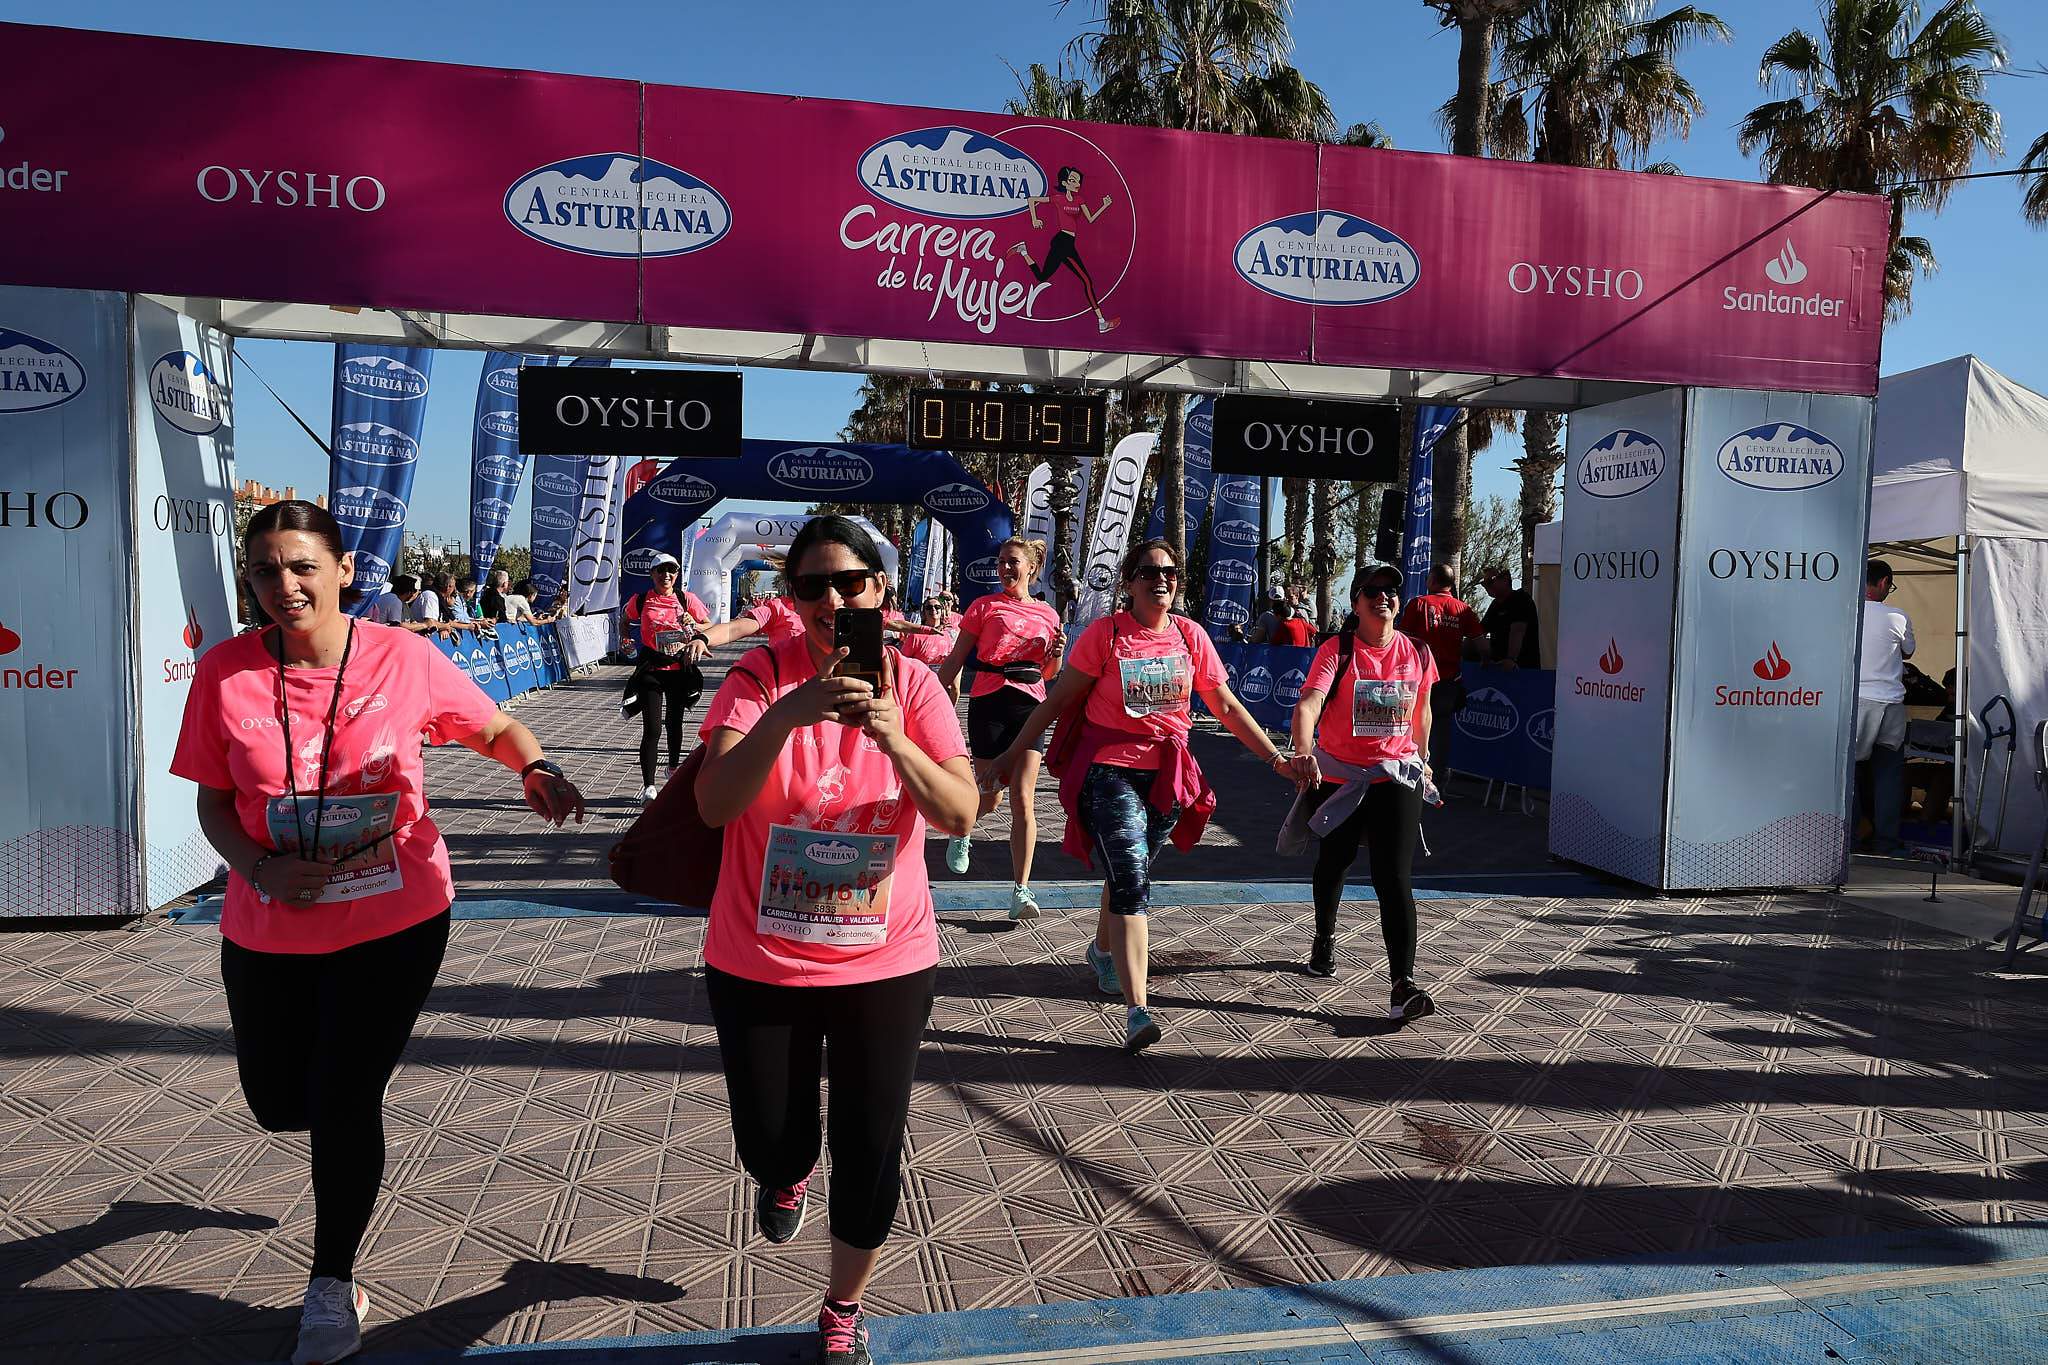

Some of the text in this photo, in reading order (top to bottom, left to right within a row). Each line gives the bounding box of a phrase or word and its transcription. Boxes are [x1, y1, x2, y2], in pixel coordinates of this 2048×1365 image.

[0, 160, 69, 192] der
[872, 154, 1031, 200] ASTURIANA
[903, 154, 1028, 174] CENTRAL LECHERA
[196, 165, 386, 212] OYSHO
[558, 186, 628, 200] CENTRAL
[522, 186, 714, 235] ASTURIANA
[839, 204, 997, 262] Carrera
[1248, 240, 1405, 284] ASTURIANA
[1277, 240, 1400, 257] CENTRAL LECHERA
[877, 256, 934, 292] de la
[1507, 262, 1644, 301] OYSHO
[928, 258, 1052, 334] Mujer
[1722, 286, 1844, 317] Santander
[340, 366, 421, 394] ASTURIANA
[156, 372, 221, 420] ASTURIANA
[556, 394, 711, 431] OYSHO
[923, 399, 1091, 443] 01:01:51
[1244, 421, 1374, 456] OYSHO
[775, 459, 866, 481] ASTURIANA
[1582, 458, 1658, 485] ASTURIANA
[1726, 446, 1834, 475] ASTURIANA
[652, 484, 711, 498] ASTURIANA
[930, 494, 985, 506] ASTURIANA
[153, 494, 226, 537] OYSHO
[755, 519, 804, 538] OYS
[1087, 456, 1139, 591] OYSHO
[1574, 549, 1660, 580] OYSHO
[1707, 548, 1840, 582] OYSHO
[1575, 675, 1646, 703] Santander
[1715, 686, 1824, 706] Santander
[808, 846, 857, 860] ASTURIANA
[331, 864, 391, 883] MUJER VALENCIA
[350, 878, 388, 893] Santander
[805, 880, 853, 900] 016
[766, 908, 797, 919] CARRERA
[799, 913, 809, 921] DE
[809, 914, 819, 922] LA
[820, 915, 844, 923] MUJER
[813, 904, 837, 914] 5833
[772, 921, 874, 938] OYSHO Santander
